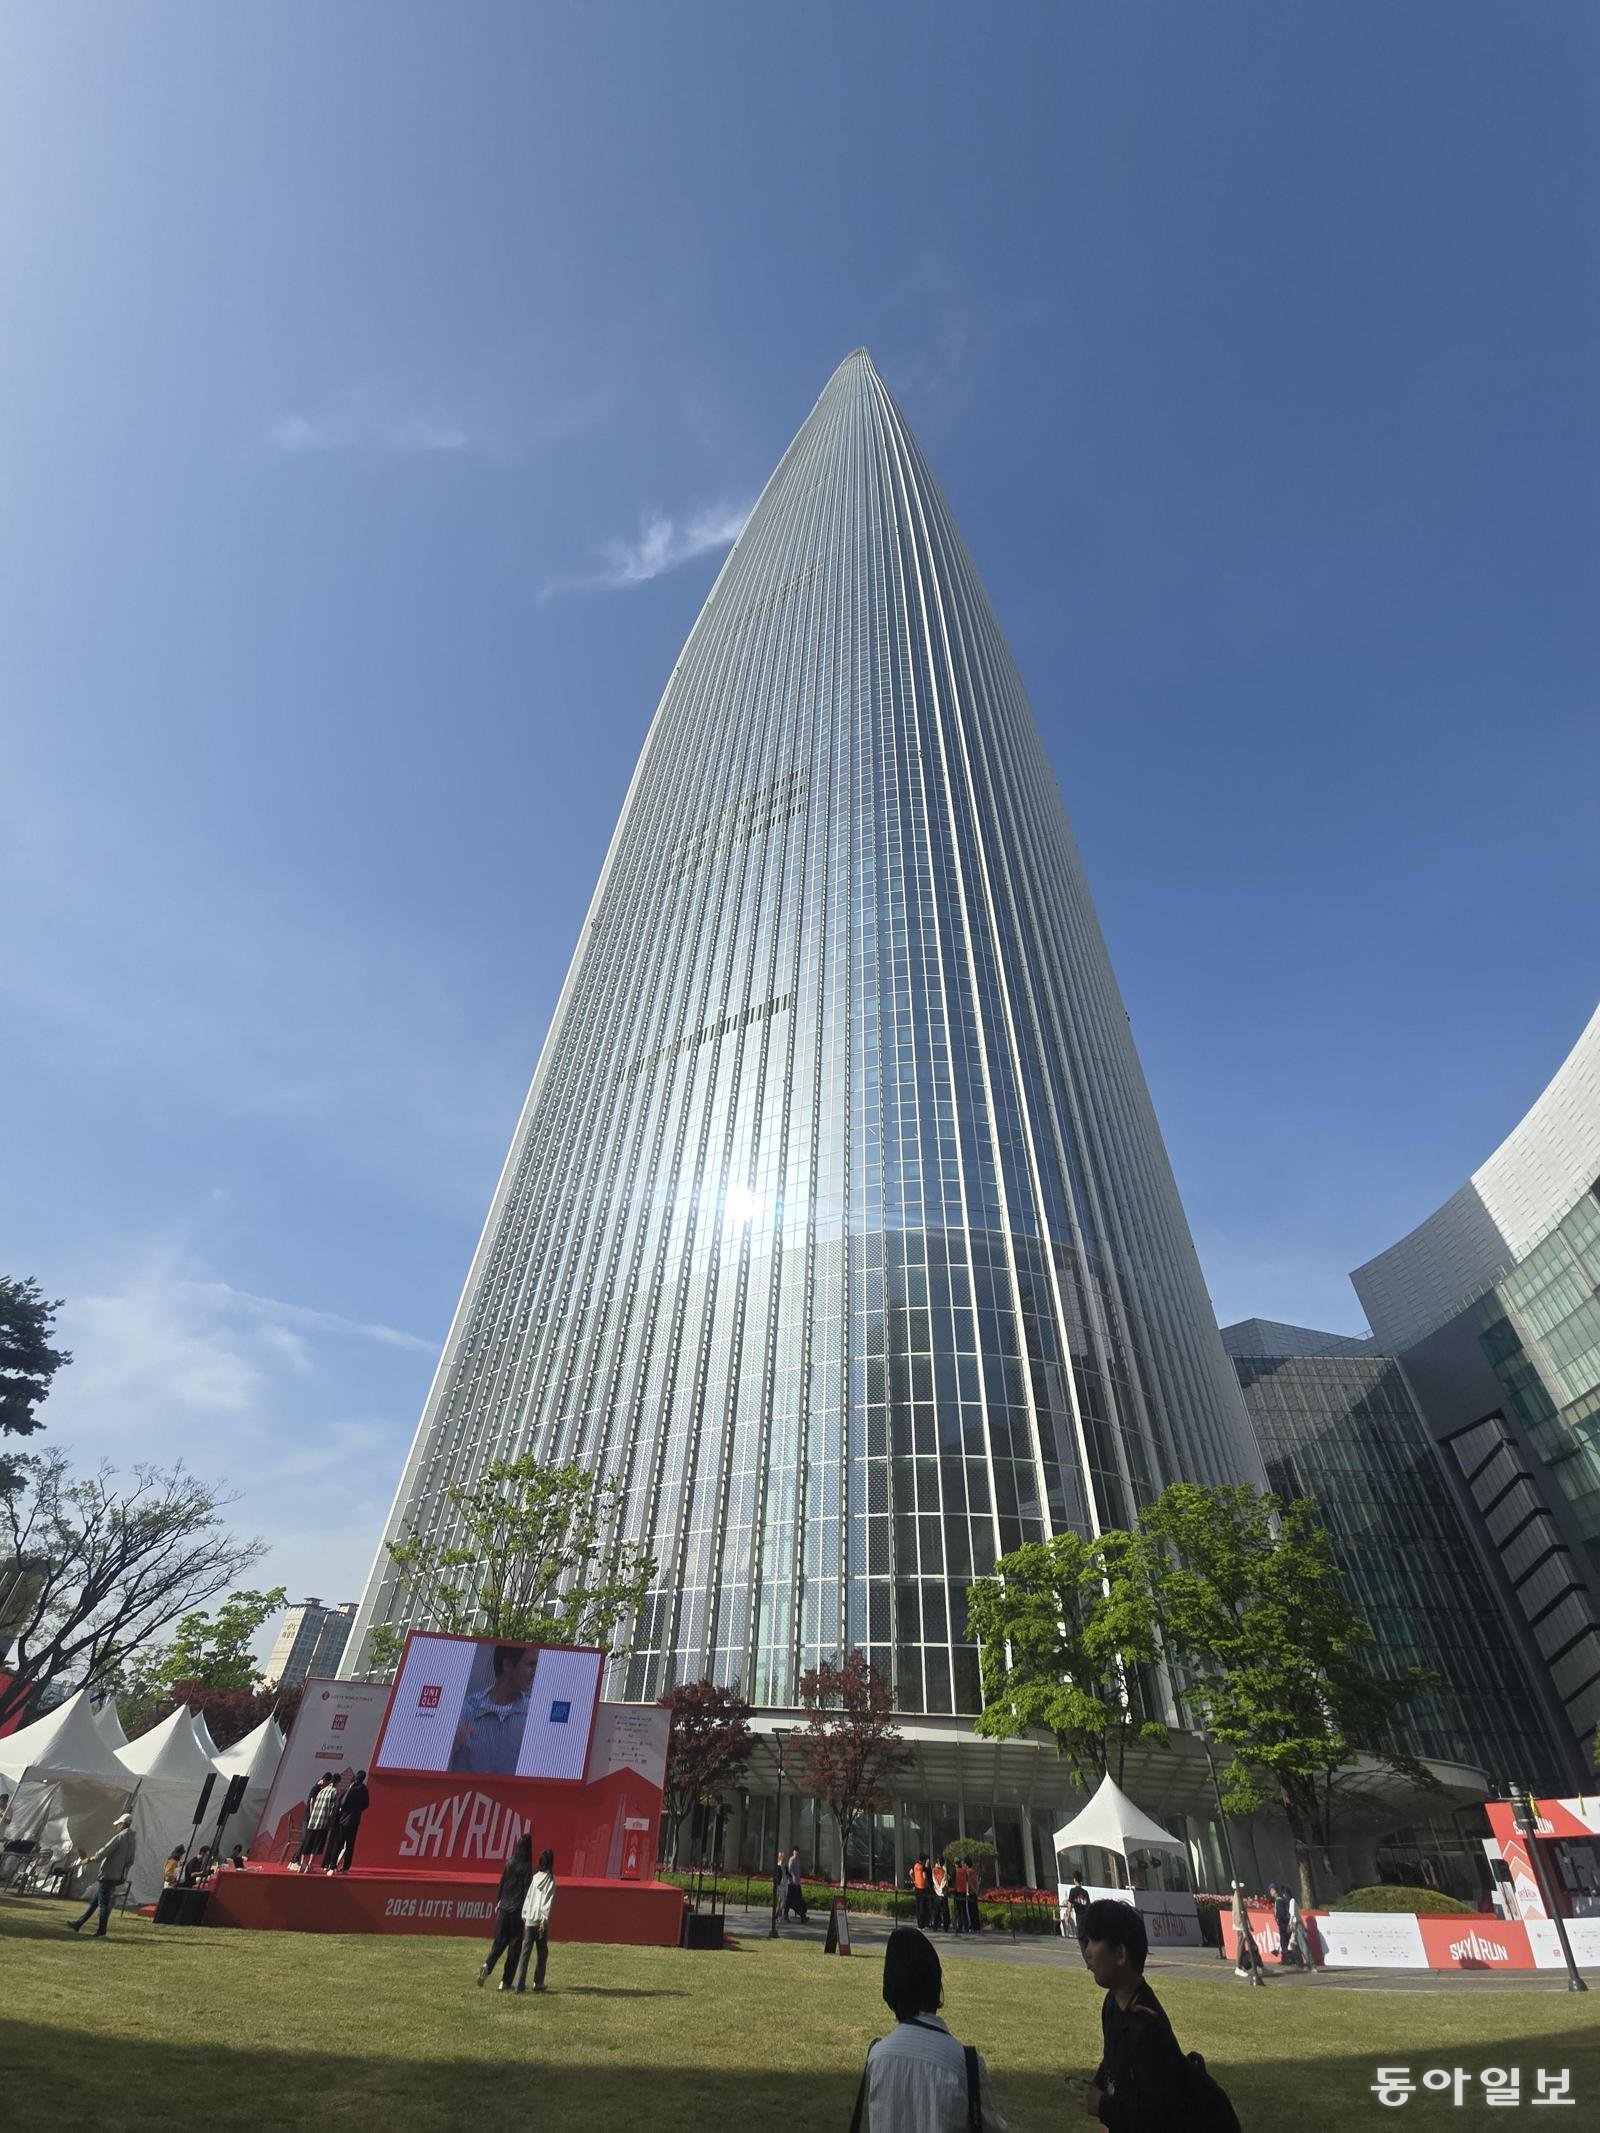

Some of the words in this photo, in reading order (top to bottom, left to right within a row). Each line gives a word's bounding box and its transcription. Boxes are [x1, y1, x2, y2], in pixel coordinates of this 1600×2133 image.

[423, 1688, 439, 1697] UNI
[421, 1696, 438, 1706] QLO
[384, 1898, 417, 1916] 2026
[418, 1900, 453, 1918] LOTTE
[456, 1901, 493, 1919] WORLD
